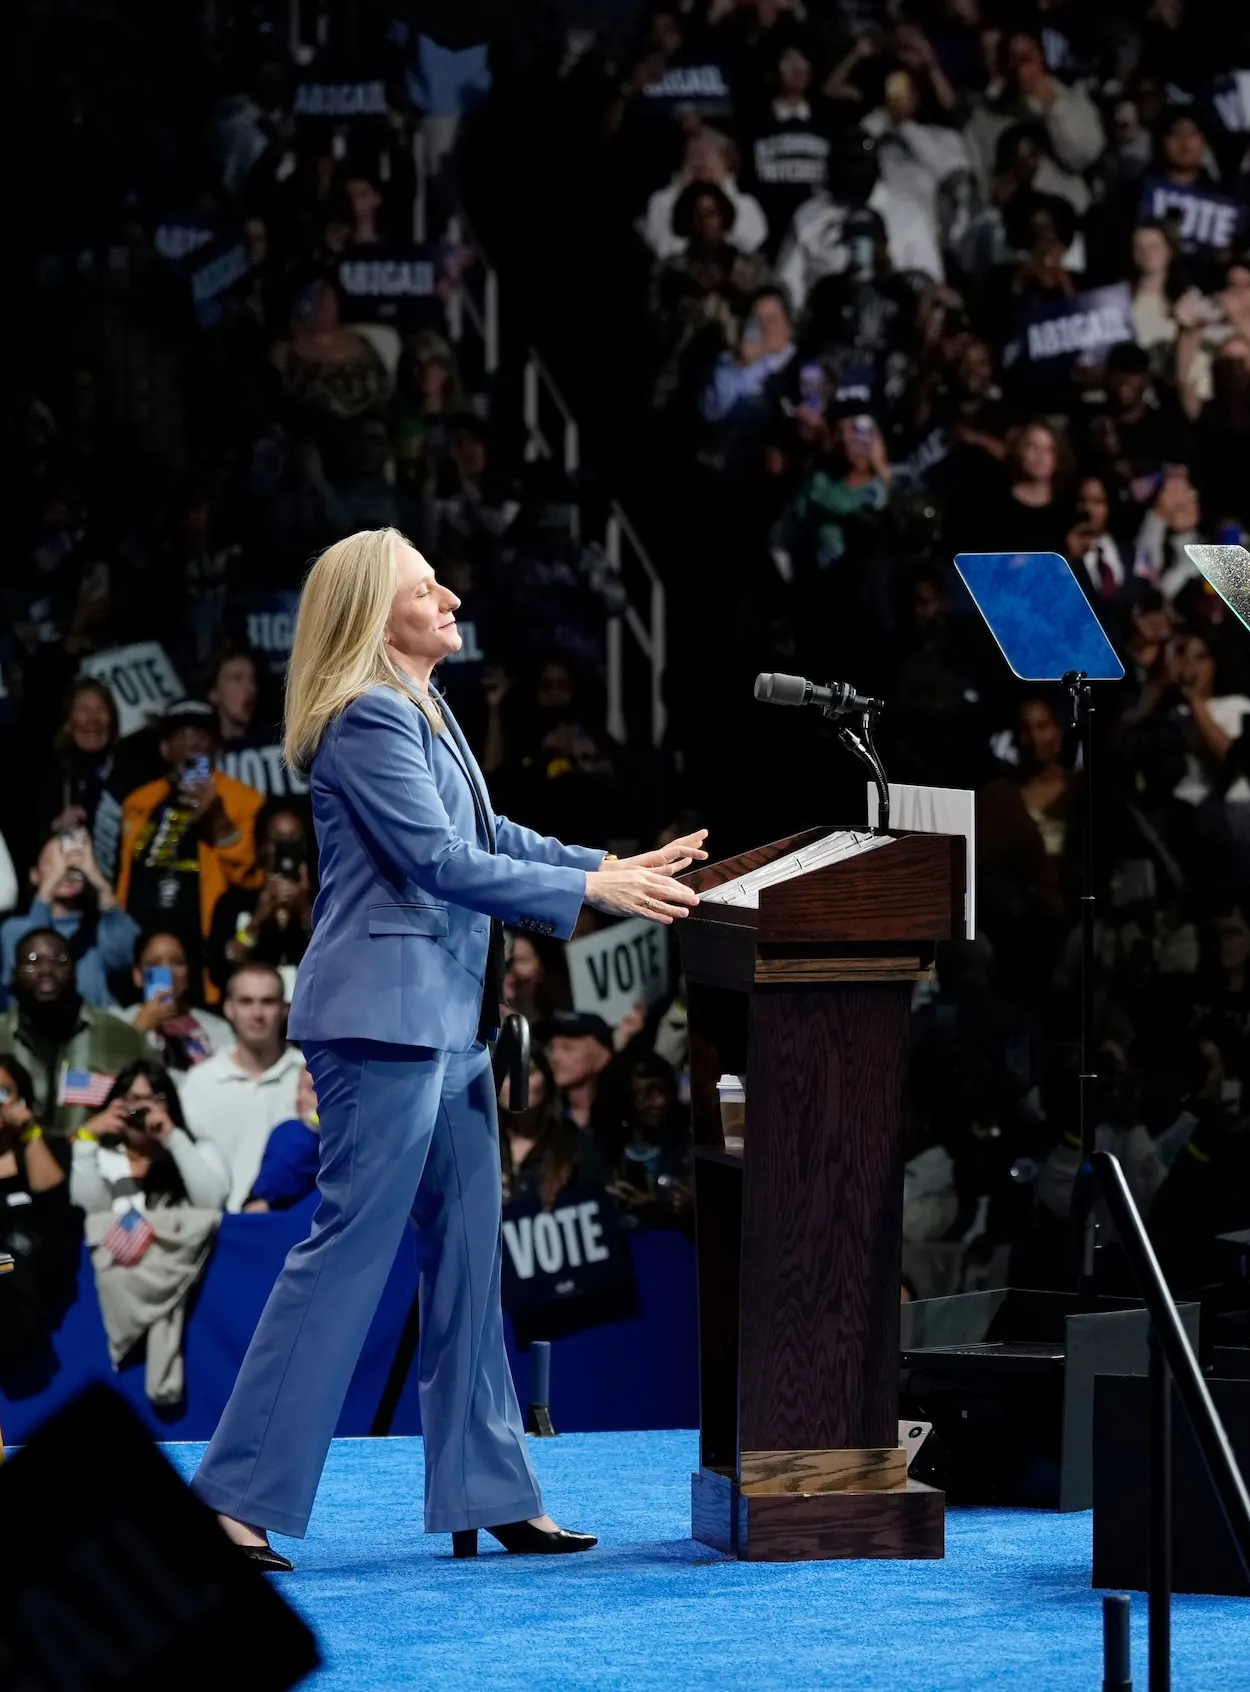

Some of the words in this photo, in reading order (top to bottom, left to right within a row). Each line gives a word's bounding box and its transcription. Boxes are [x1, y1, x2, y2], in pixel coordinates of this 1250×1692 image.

[98, 658, 173, 707] OTE
[586, 928, 660, 998] VOTE
[503, 1200, 611, 1280] VOTE
